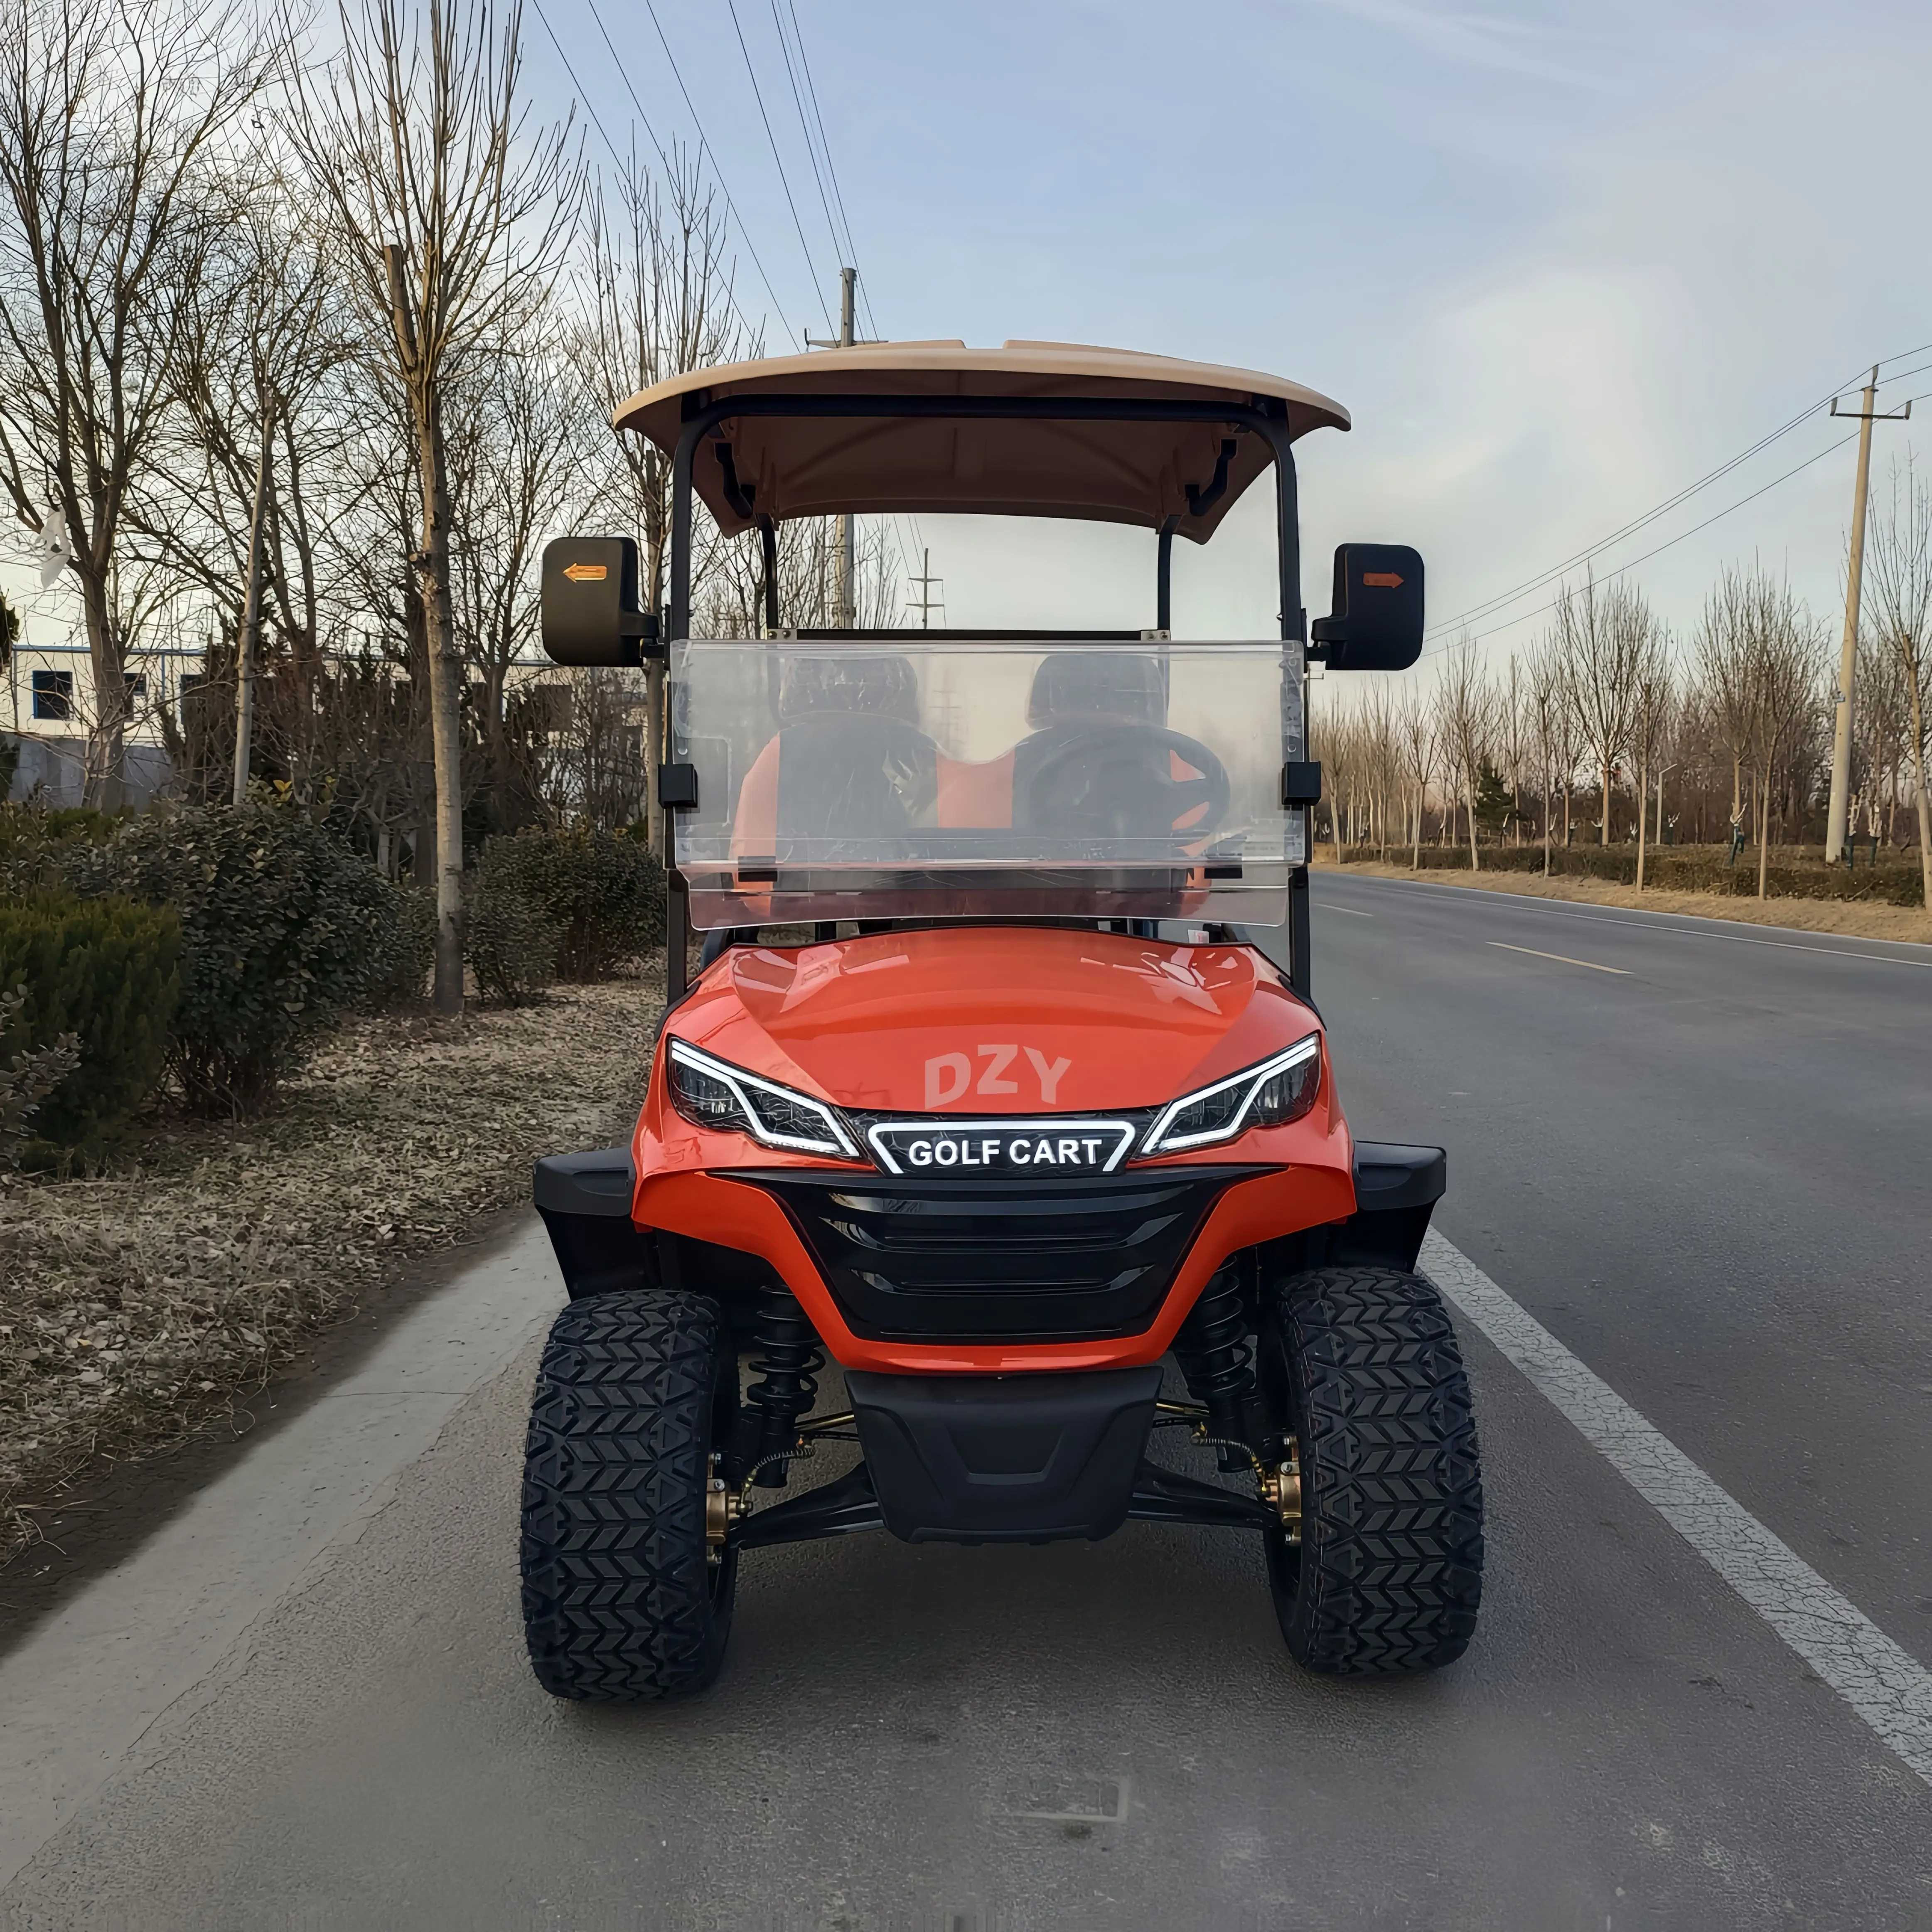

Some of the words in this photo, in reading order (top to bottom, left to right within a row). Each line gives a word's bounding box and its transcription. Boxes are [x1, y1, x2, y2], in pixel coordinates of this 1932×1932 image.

[925, 1044, 1072, 1110] DZY
[908, 1140, 1000, 1166] GOLF
[1009, 1139, 1102, 1165] CART
